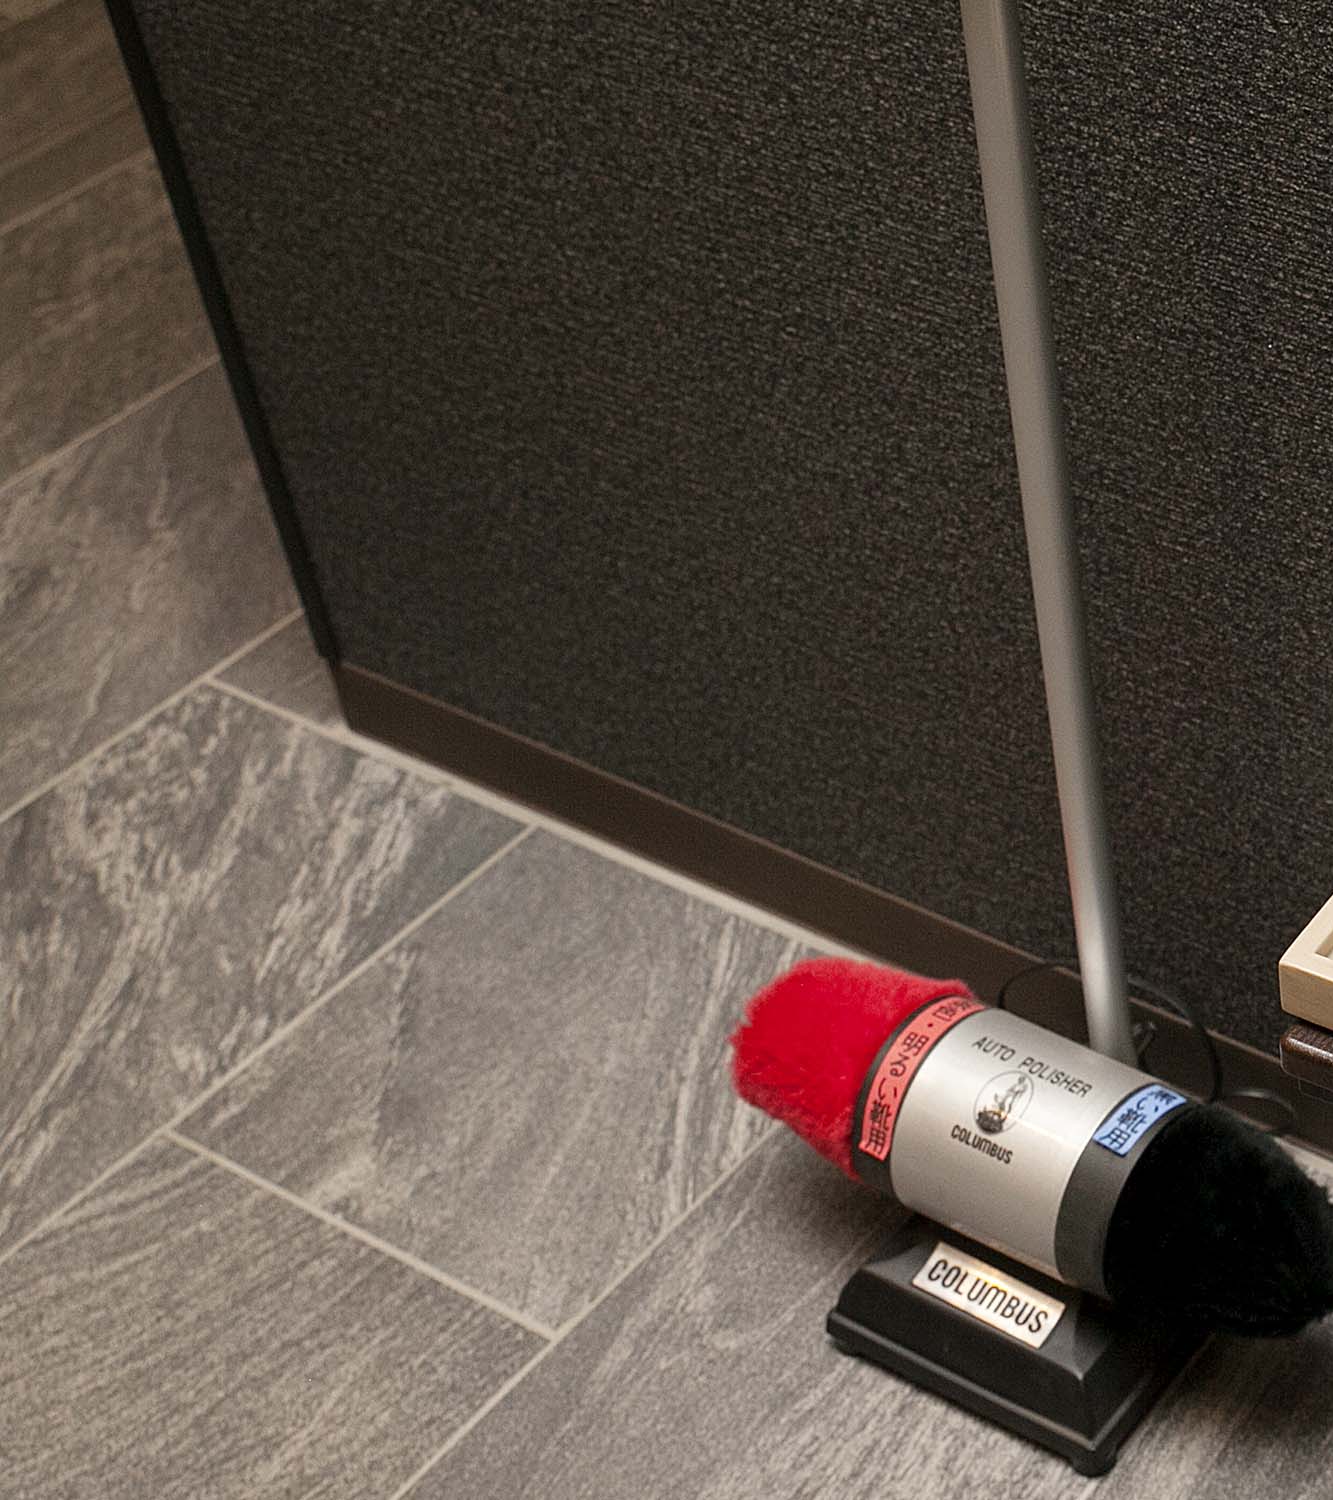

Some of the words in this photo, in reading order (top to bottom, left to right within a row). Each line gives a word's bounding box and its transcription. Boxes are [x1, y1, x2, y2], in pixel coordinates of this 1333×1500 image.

[972, 1036, 1016, 1062] AUTO
[1018, 1057, 1093, 1098] POLISHER
[951, 1124, 1013, 1164] COLUMBUS
[927, 1258, 1049, 1335] COLUMBUS
